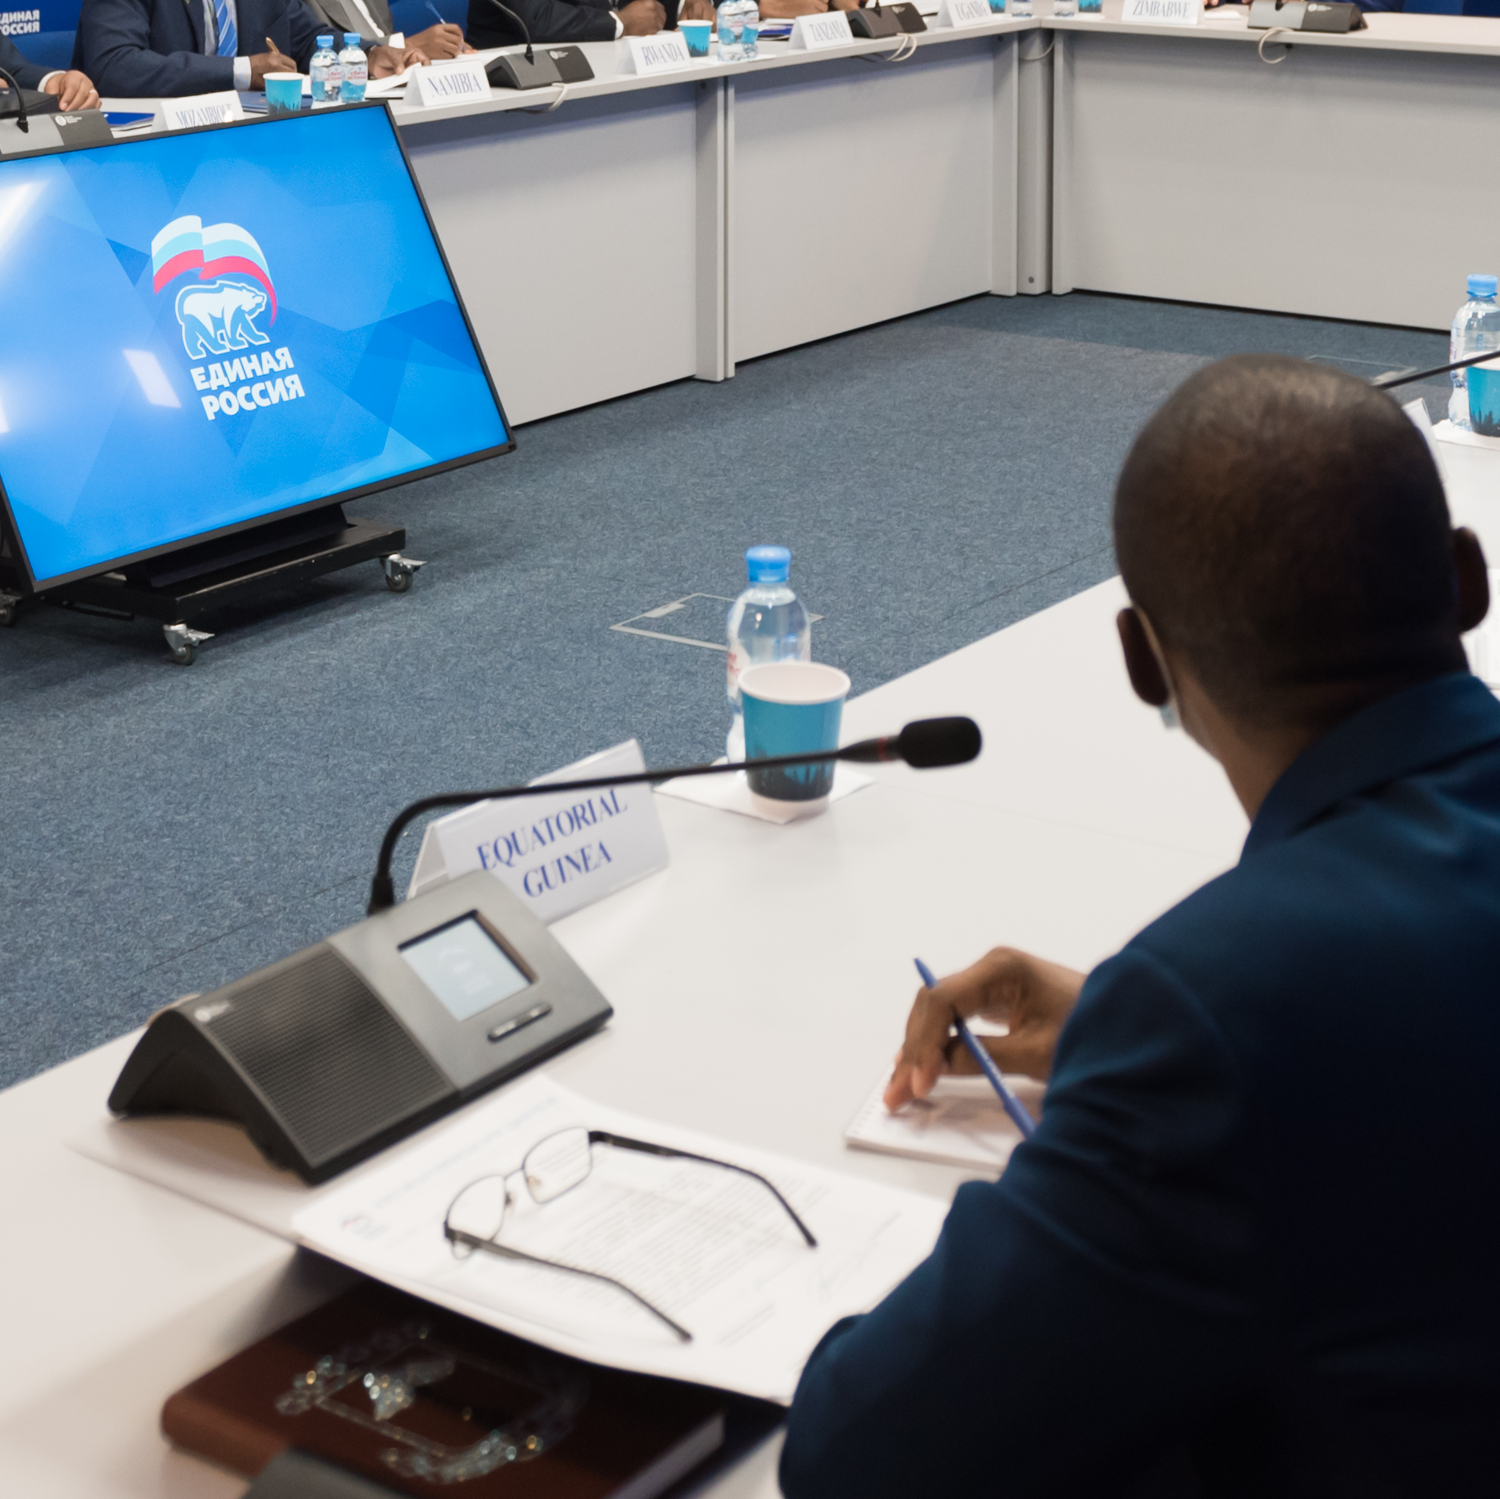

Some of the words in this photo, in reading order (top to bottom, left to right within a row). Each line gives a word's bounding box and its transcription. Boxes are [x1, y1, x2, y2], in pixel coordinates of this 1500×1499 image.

[1133, 0, 1191, 19] ZIMBABWE
[642, 43, 685, 66] RWANDA
[427, 72, 482, 98] NAMIBIA
[190, 347, 294, 390] ЕДИНАЯ
[201, 374, 305, 420] РОССИЯ
[477, 789, 628, 872] EQUATORIAL
[523, 840, 613, 898] GUINEA
